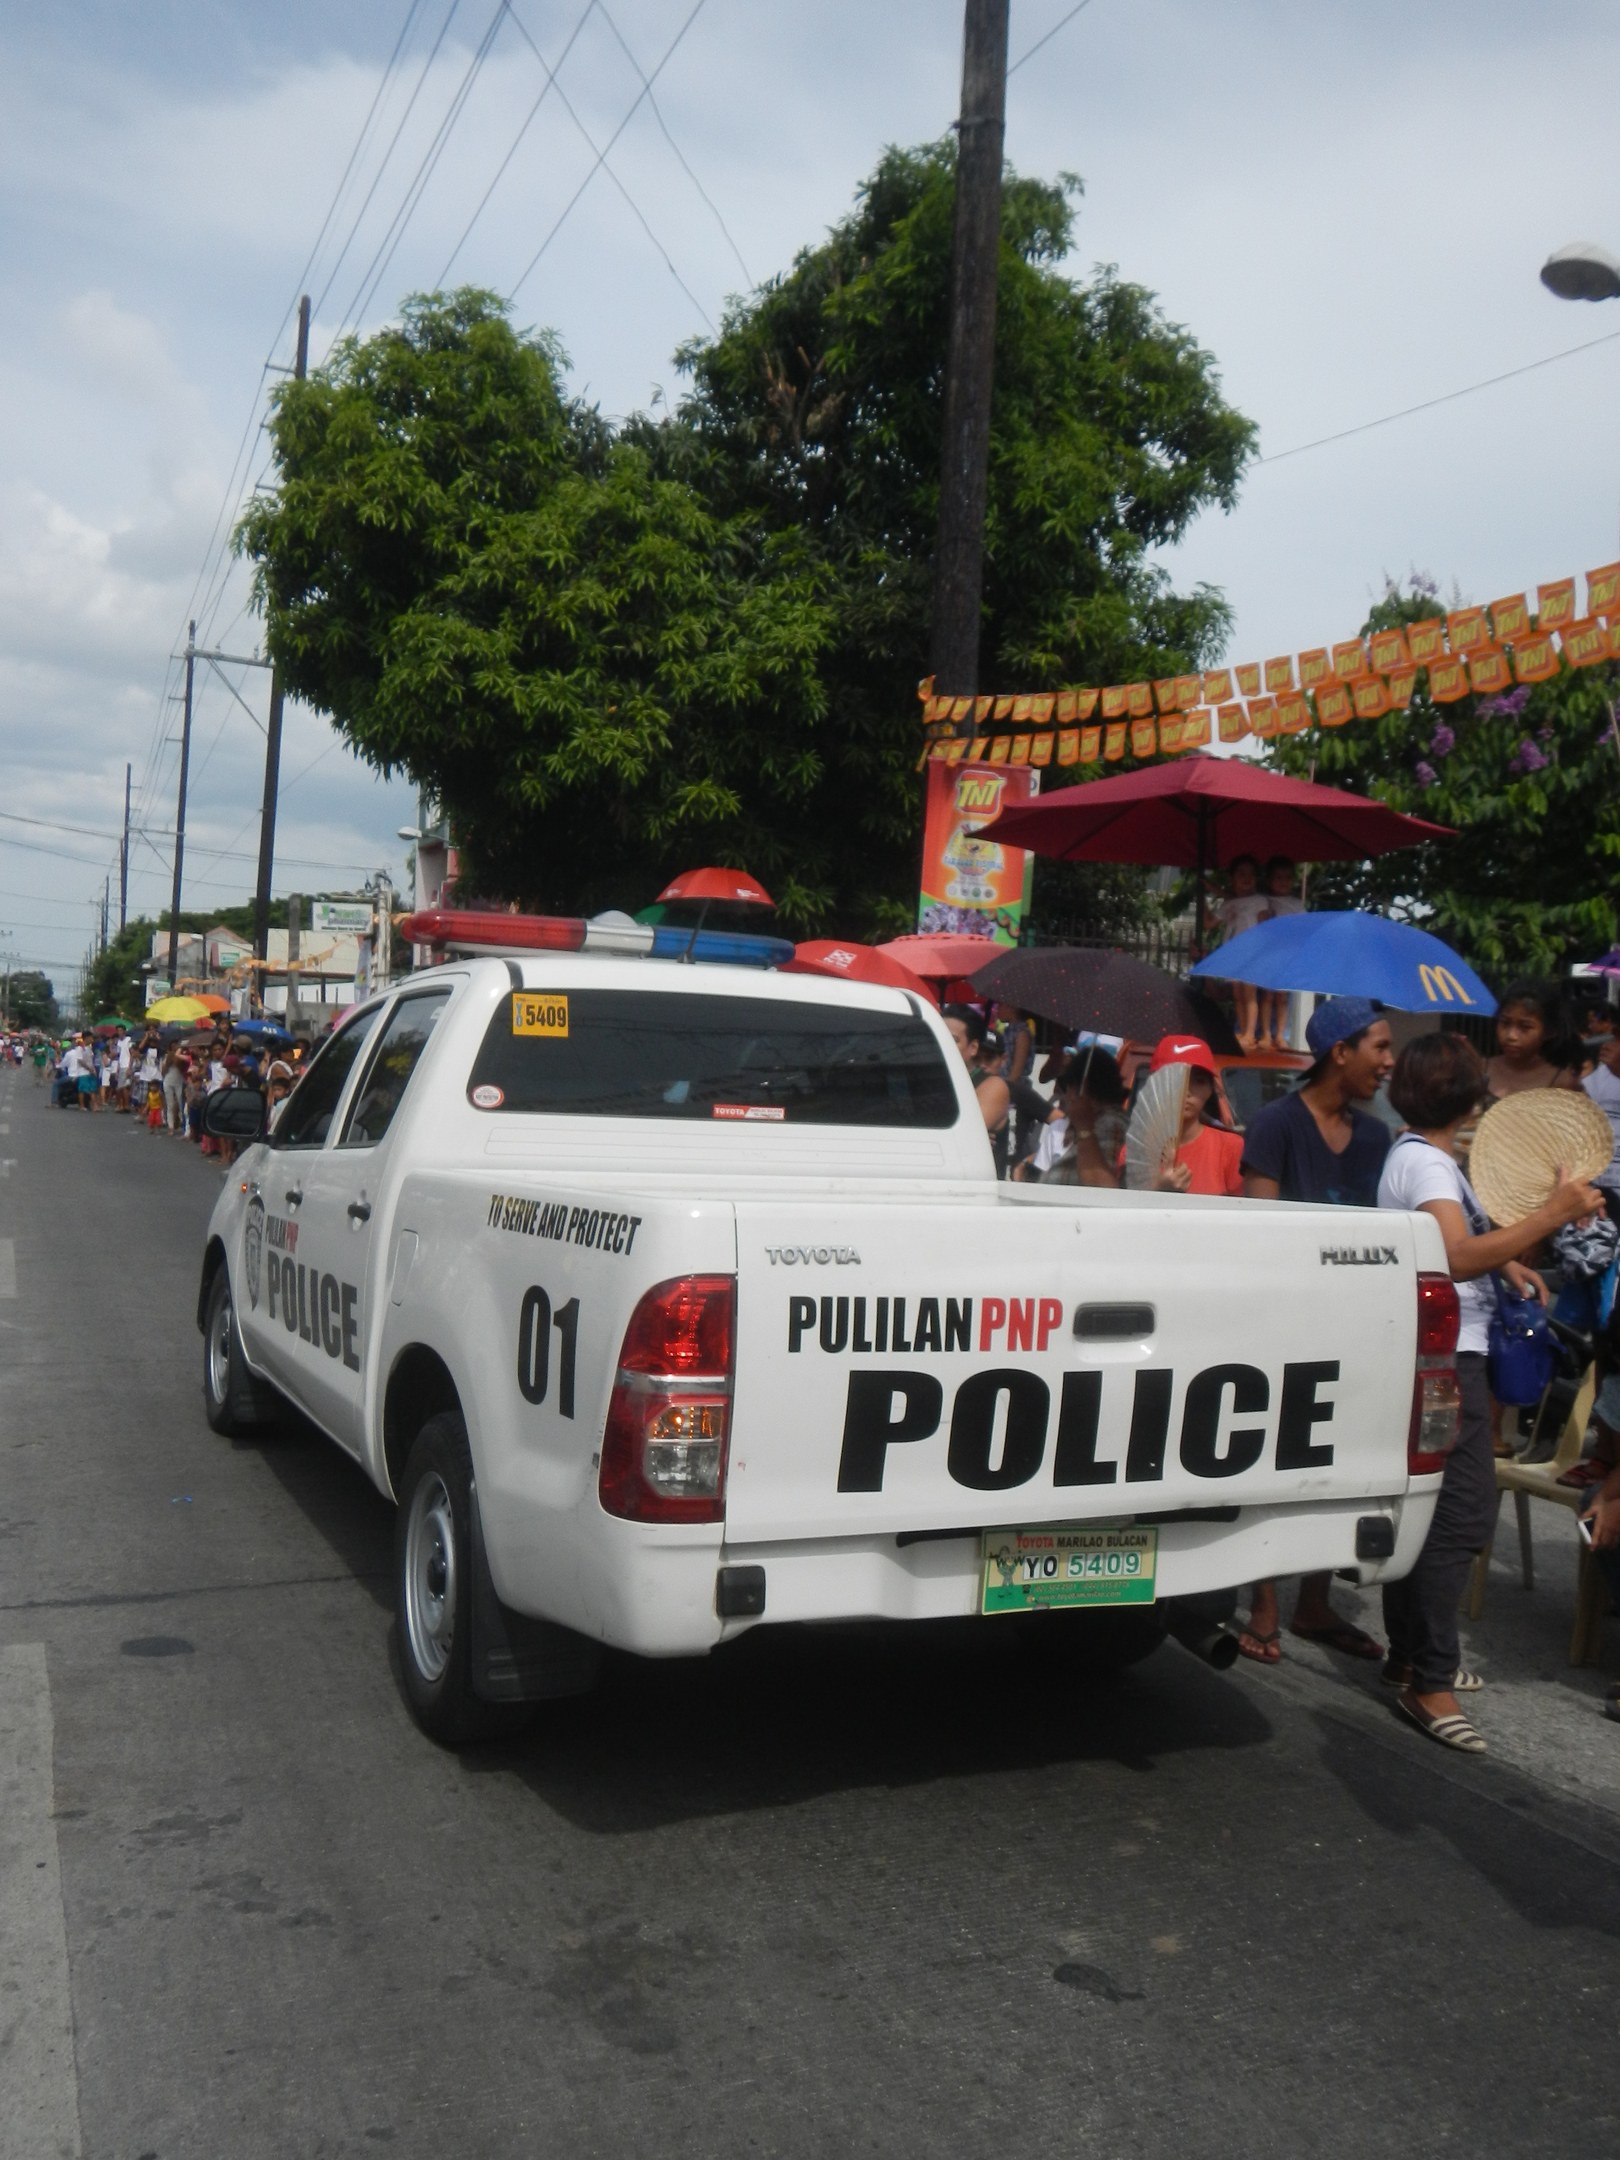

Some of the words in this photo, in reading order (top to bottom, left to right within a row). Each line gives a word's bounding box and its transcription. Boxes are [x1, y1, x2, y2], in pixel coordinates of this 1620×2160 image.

[957, 777, 1007, 808] TNT
[526, 1004, 567, 1028] 5409
[714, 1106, 745, 1116] TOYOTA
[487, 1194, 504, 1228] TO
[502, 1196, 541, 1236] SERVE
[536, 1202, 568, 1241] AND
[565, 1206, 643, 1256] PROTECT
[765, 1245, 861, 1266] TOYOTA
[1319, 1245, 1399, 1266] HILUX
[267, 1250, 360, 1373] POLICE
[788, 1296, 973, 1353] PULILAN
[979, 1297, 1064, 1352] PNP
[517, 1285, 580, 1420] 01
[837, 1360, 1341, 1493] POLICE
[1016, 1535, 1054, 1549] TOYOTA
[1056, 1535, 1104, 1548] MARILAO
[1106, 1534, 1148, 1548] BULACAN
[1026, 1554, 1058, 1578] YO
[1069, 1552, 1141, 1576] 5409
